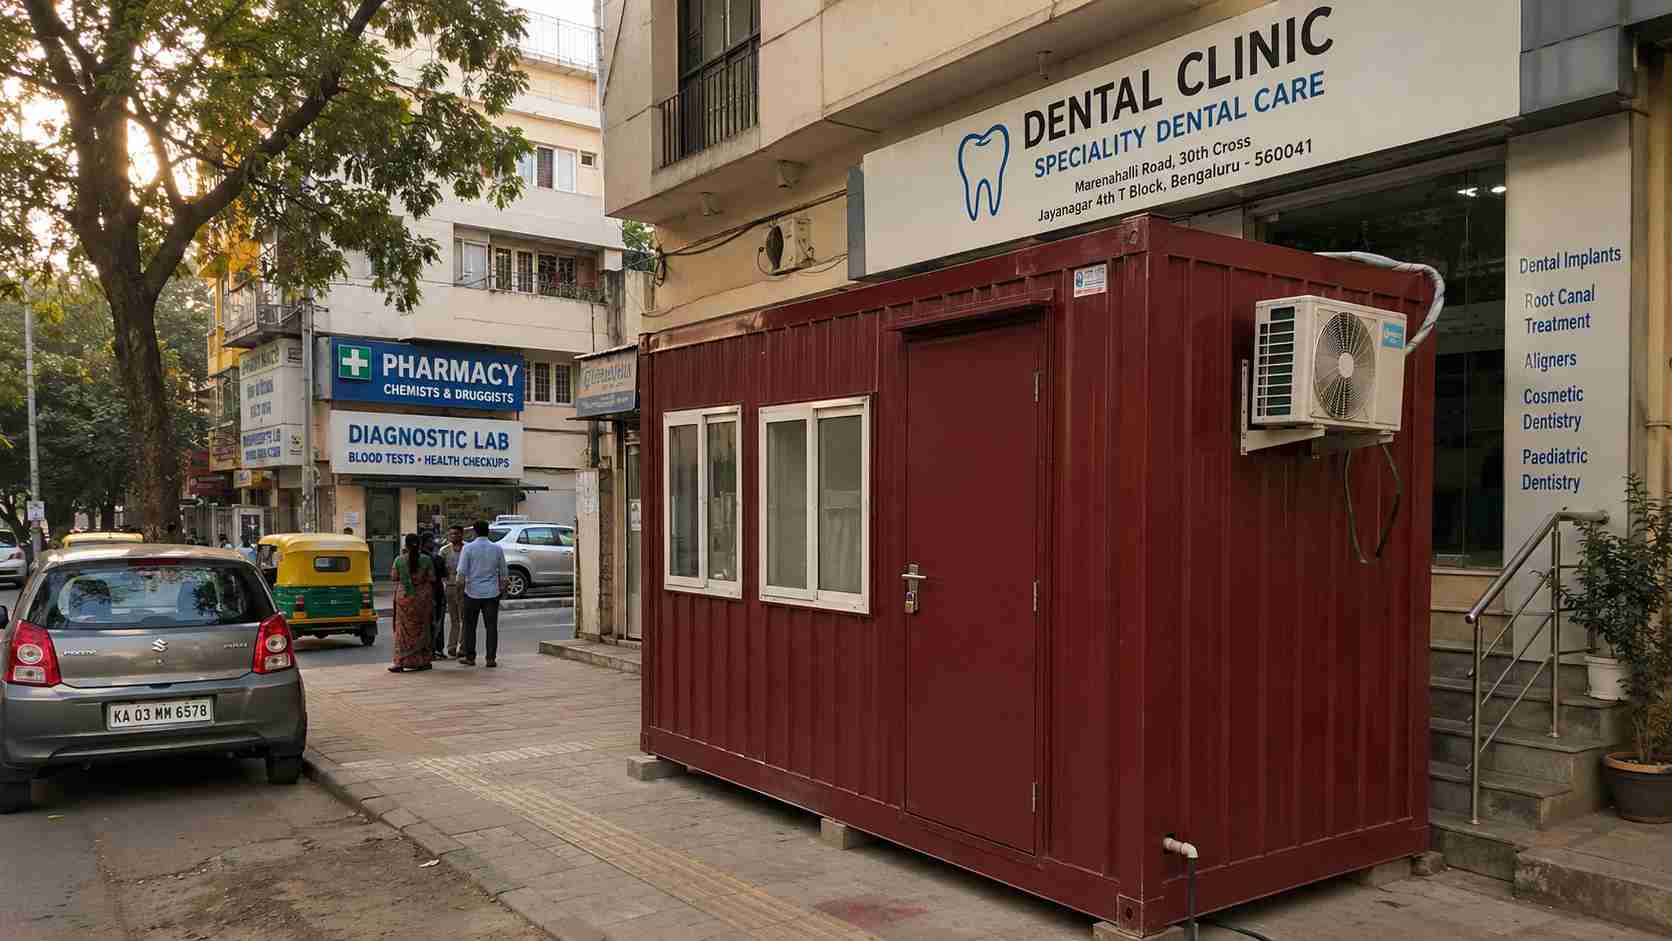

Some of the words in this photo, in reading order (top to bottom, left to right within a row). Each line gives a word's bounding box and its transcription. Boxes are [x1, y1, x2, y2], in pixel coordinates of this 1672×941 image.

[1024, 69, 1163, 149] DENTAL
[1177, 6, 1334, 96] CLINIC
[1034, 125, 1146, 178] SPECIALITY
[1157, 99, 1247, 144] DENTAL
[1254, 71, 1325, 113] CARE
[1074, 162, 1139, 193] Marenahalli
[1142, 155, 1175, 178] Road,
[1179, 146, 1209, 166] 30th
[1212, 135, 1251, 158] Cross
[1038, 197, 1093, 222] Jayanagar
[1096, 189, 1115, 207] 4th
[1118, 188, 1127, 203] T
[1129, 179, 1167, 200] Block,
[1171, 161, 1240, 191] Bengaluru
[1254, 138, 1312, 167] 560041
[1519, 252, 1560, 274] Dental
[1564, 247, 1621, 269] Implants
[1525, 292, 1554, 309] Root
[1558, 284, 1595, 305] Canal
[1525, 313, 1591, 334] Treatment
[383, 353, 518, 386] PHARMACY
[1525, 351, 1577, 372] Aligners
[384, 384, 440, 398] CHEMISTS
[443, 389, 451, 399] &
[455, 389, 514, 403] DRUGGISTS
[1524, 385, 1584, 405] Cosmetic
[1523, 412, 1582, 432] Dentistry
[349, 424, 467, 449] DIAGNOSTIC
[474, 431, 509, 450] LAB
[348, 452, 382, 464] BLOOD
[385, 453, 415, 465] TESTS
[424, 455, 460, 466] HEALTH
[462, 456, 510, 468] CHECKUPS
[1523, 448, 1588, 465] Paediatric
[1522, 474, 1581, 494] Dentistry
[113, 708, 131, 723] KA
[134, 707, 151, 721] 03
[154, 706, 172, 720] MM
[175, 704, 207, 719] 6578
